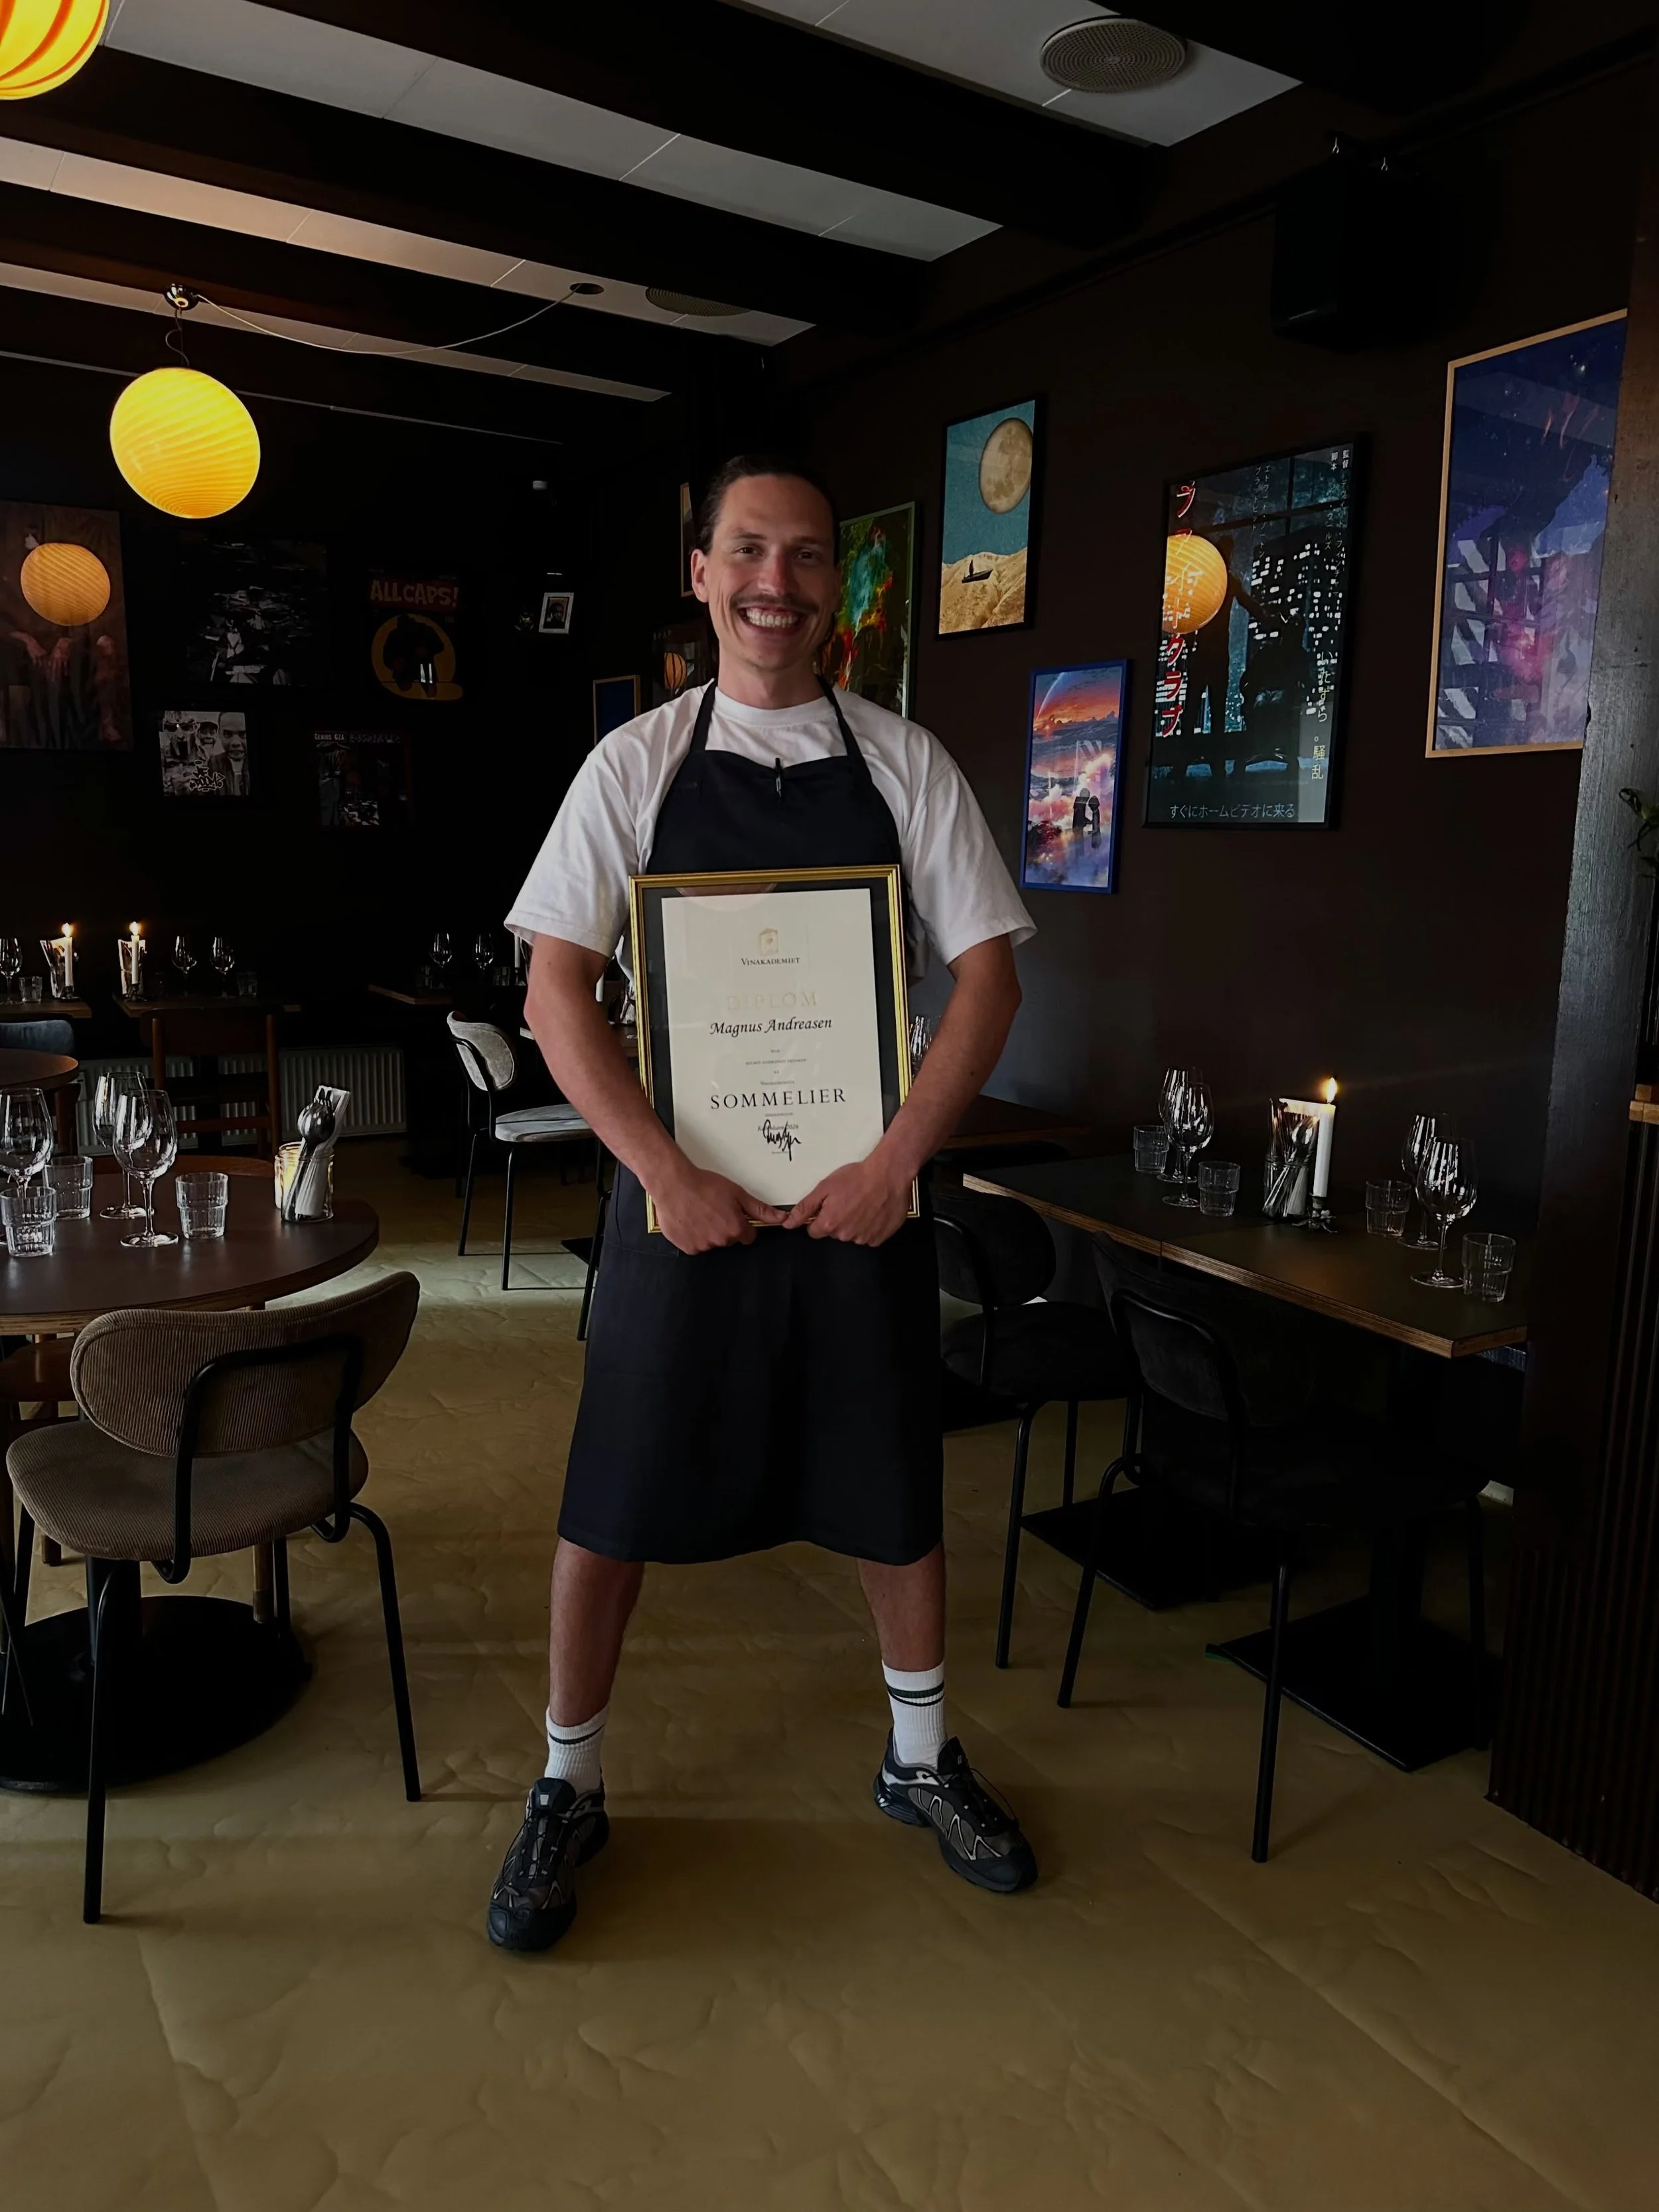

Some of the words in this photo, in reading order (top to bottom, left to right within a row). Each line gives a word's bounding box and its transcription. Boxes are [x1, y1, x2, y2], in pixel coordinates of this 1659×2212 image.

[369, 578, 402, 602] ALL
[403, 583, 459, 609] CAPS!
[727, 991, 818, 1011] DIPLOM
[709, 1022, 763, 1038] Magnus
[764, 1016, 833, 1033] Andreasen
[710, 1088, 846, 1110] SOMMELIER
